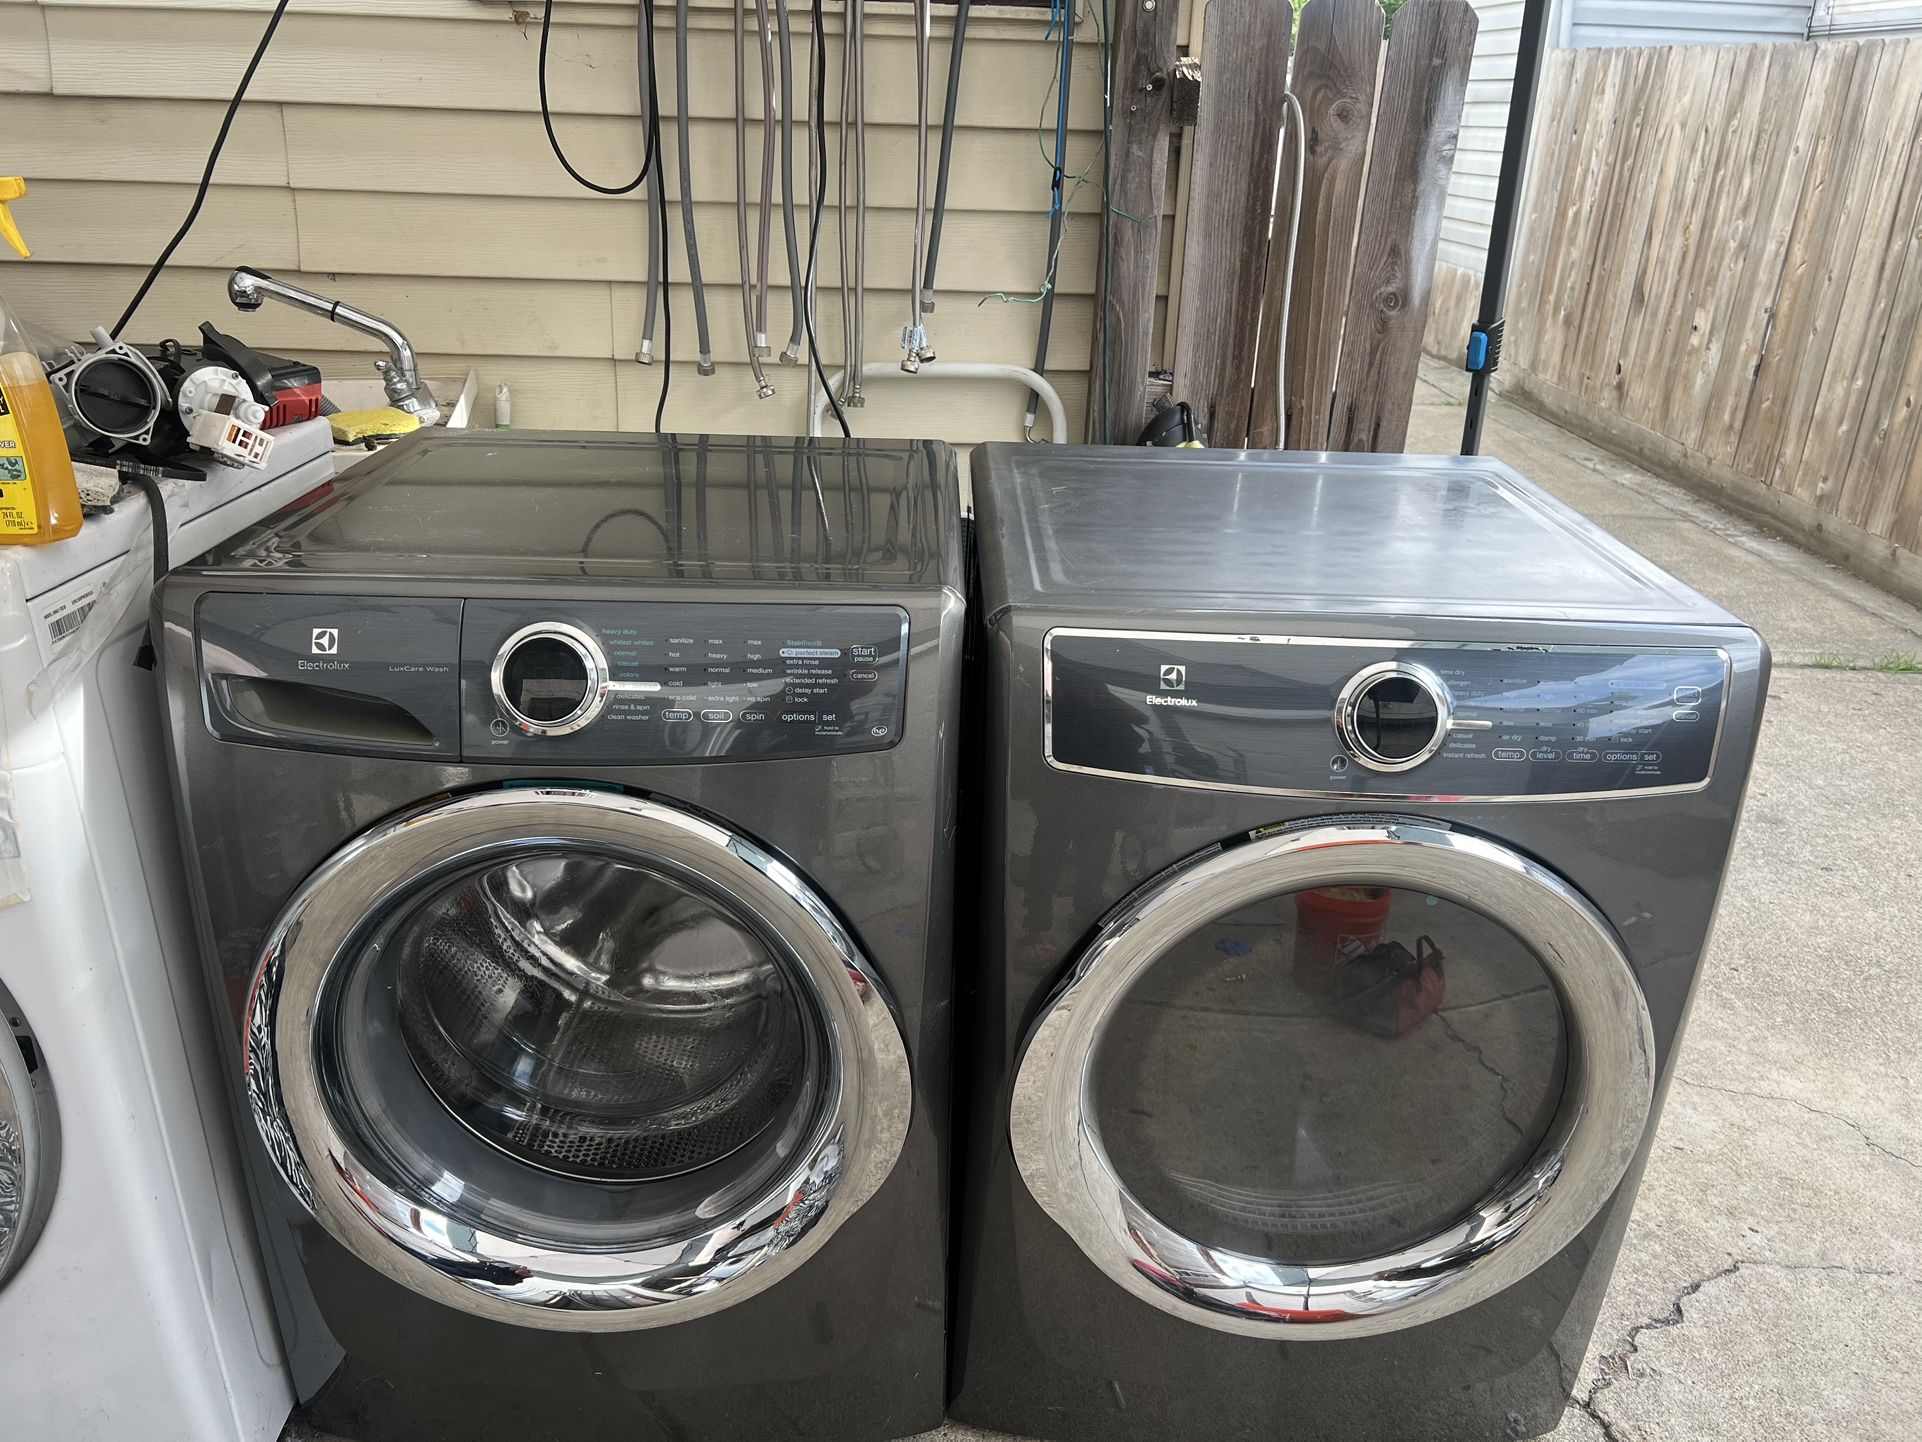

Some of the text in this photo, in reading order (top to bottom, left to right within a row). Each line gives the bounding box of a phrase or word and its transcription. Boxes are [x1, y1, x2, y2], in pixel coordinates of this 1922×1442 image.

[602, 628, 637, 636] heavy duty
[795, 649, 818, 657] perfect
[853, 646, 875, 656] start
[708, 652, 728, 660] heavy
[747, 653, 762, 661] high
[298, 660, 350, 671] Electrolux
[708, 680, 722, 688] light
[725, 695, 739, 703] light
[1146, 695, 1198, 707] Electrolux
[636, 704, 650, 712] spin
[665, 710, 689, 720] temp
[708, 711, 724, 720] soil
[745, 712, 765, 722] spin
[782, 712, 836, 722] options set
[1498, 751, 1520, 759] temp
[1536, 751, 1555, 759] level
[1606, 753, 1638, 761] options
